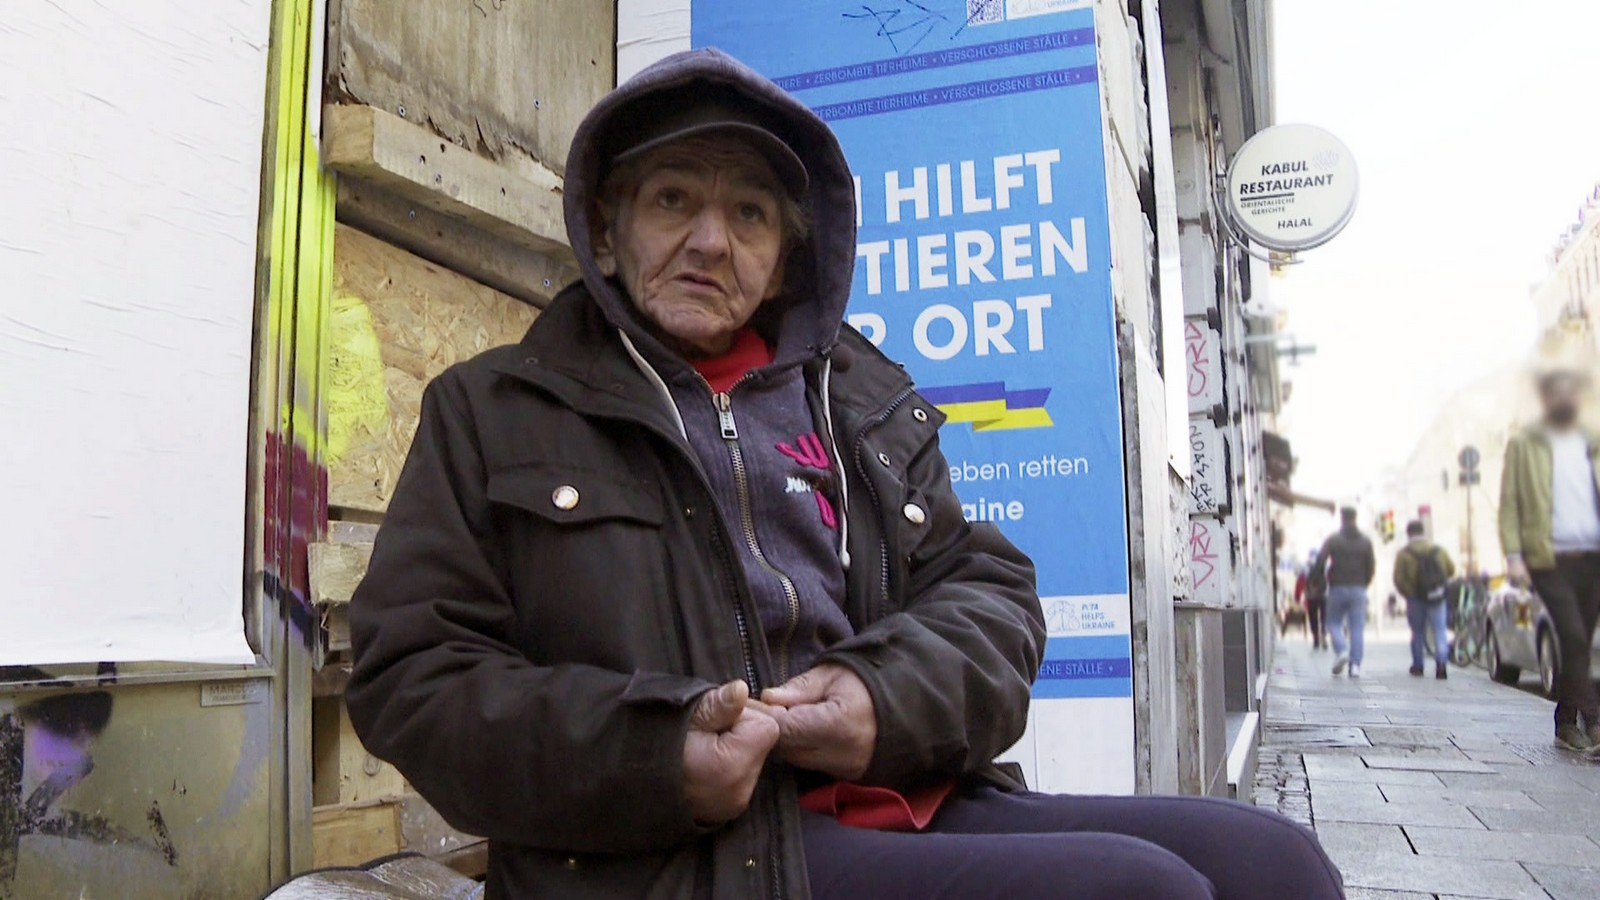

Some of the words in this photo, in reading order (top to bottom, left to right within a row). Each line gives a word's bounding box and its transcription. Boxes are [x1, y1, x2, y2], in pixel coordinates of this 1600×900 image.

[814, 65, 873, 84] ZERBOMBTE
[876, 56, 928, 73] TIERHEIME
[940, 40, 1030, 64] VERSCHLOSSENE
[1033, 33, 1069, 49] STÄLLE
[876, 93, 929, 110] TIERHEIME
[941, 77, 1032, 102] VERSCHLOSSENE
[1034, 71, 1071, 87] STÄLLE
[1261, 160, 1309, 177] KABUL
[884, 148, 1061, 224] HILFT
[1239, 173, 1334, 195] RESTAURANT
[1240, 197, 1296, 209] ORIENTALISCHE
[1251, 206, 1286, 216] GERICHTE
[1277, 217, 1313, 230] HALAL
[856, 217, 1089, 296] TIEREN
[912, 293, 1053, 361] ORT
[949, 460, 1010, 483] eben
[1018, 454, 1089, 479] retten
[963, 497, 1025, 522] aine
[1081, 612, 1105, 621] HELPS
[1081, 621, 1116, 630] UKRAINE
